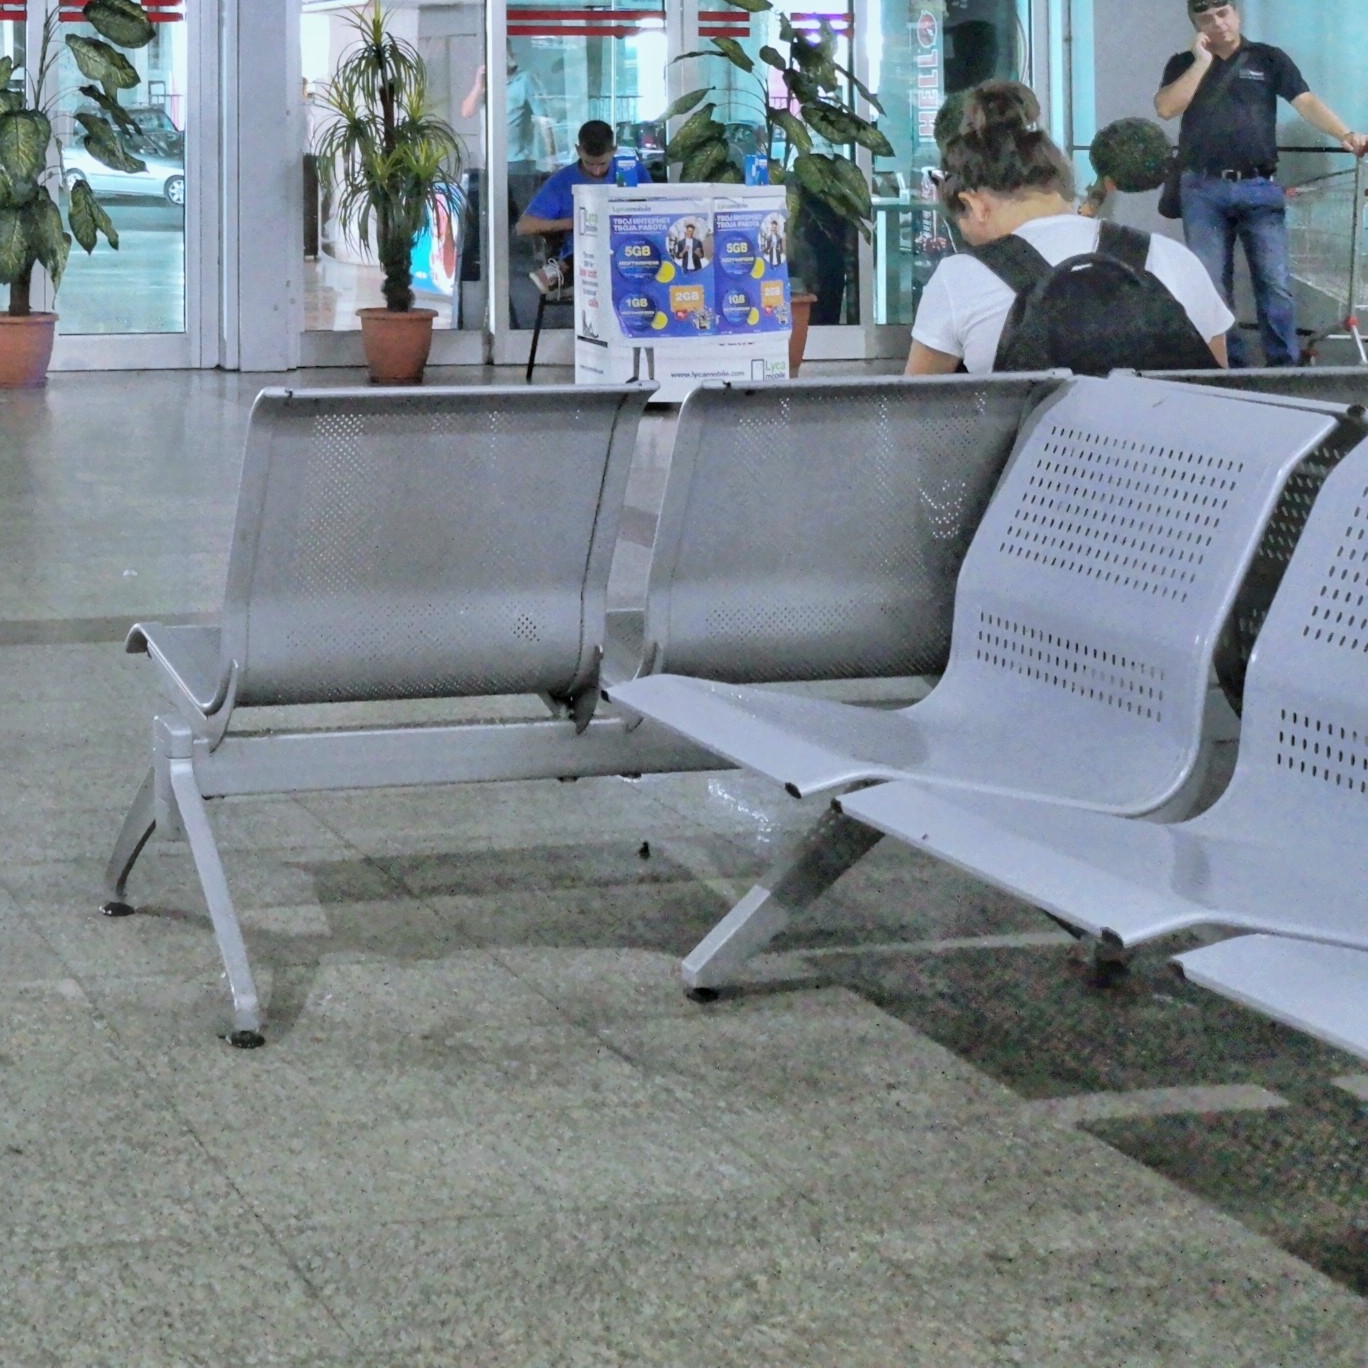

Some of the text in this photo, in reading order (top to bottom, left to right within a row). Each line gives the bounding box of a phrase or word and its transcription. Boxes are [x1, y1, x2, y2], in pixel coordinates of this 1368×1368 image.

[624, 245, 651, 257] 5GB
[726, 241, 748, 253] 5GB
[675, 291, 699, 301] 2GB
[764, 286, 781, 296] 2GB
[626, 298, 648, 308] 1GB
[728, 294, 746, 304] 1GB
[765, 360, 786, 372] Lyca
